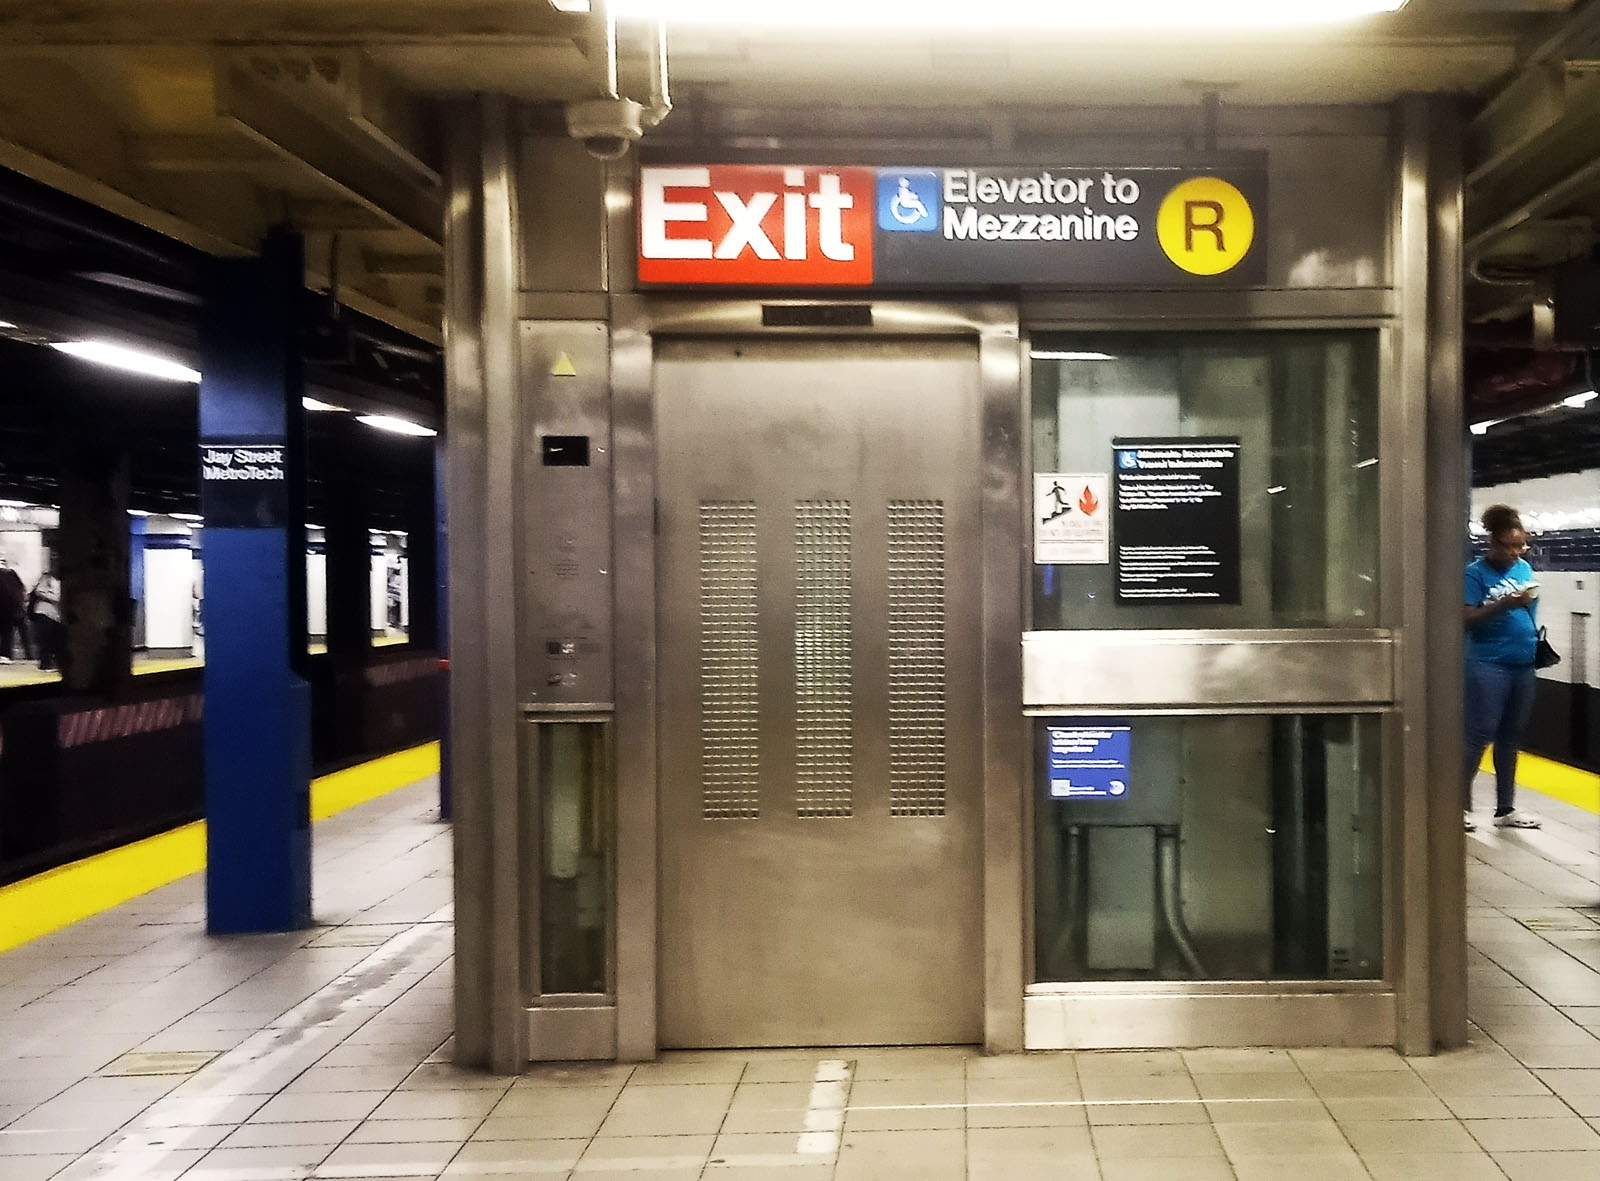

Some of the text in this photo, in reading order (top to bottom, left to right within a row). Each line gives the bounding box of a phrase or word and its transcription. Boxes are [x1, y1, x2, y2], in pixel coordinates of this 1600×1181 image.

[943, 170, 1140, 204] Elevator to
[640, 168, 855, 261] Exit
[943, 205, 1139, 241] Mezzanine
[1184, 200, 1227, 252] R
[202, 465, 284, 480] MetroTech
[203, 449, 283, 467] Jay Street
